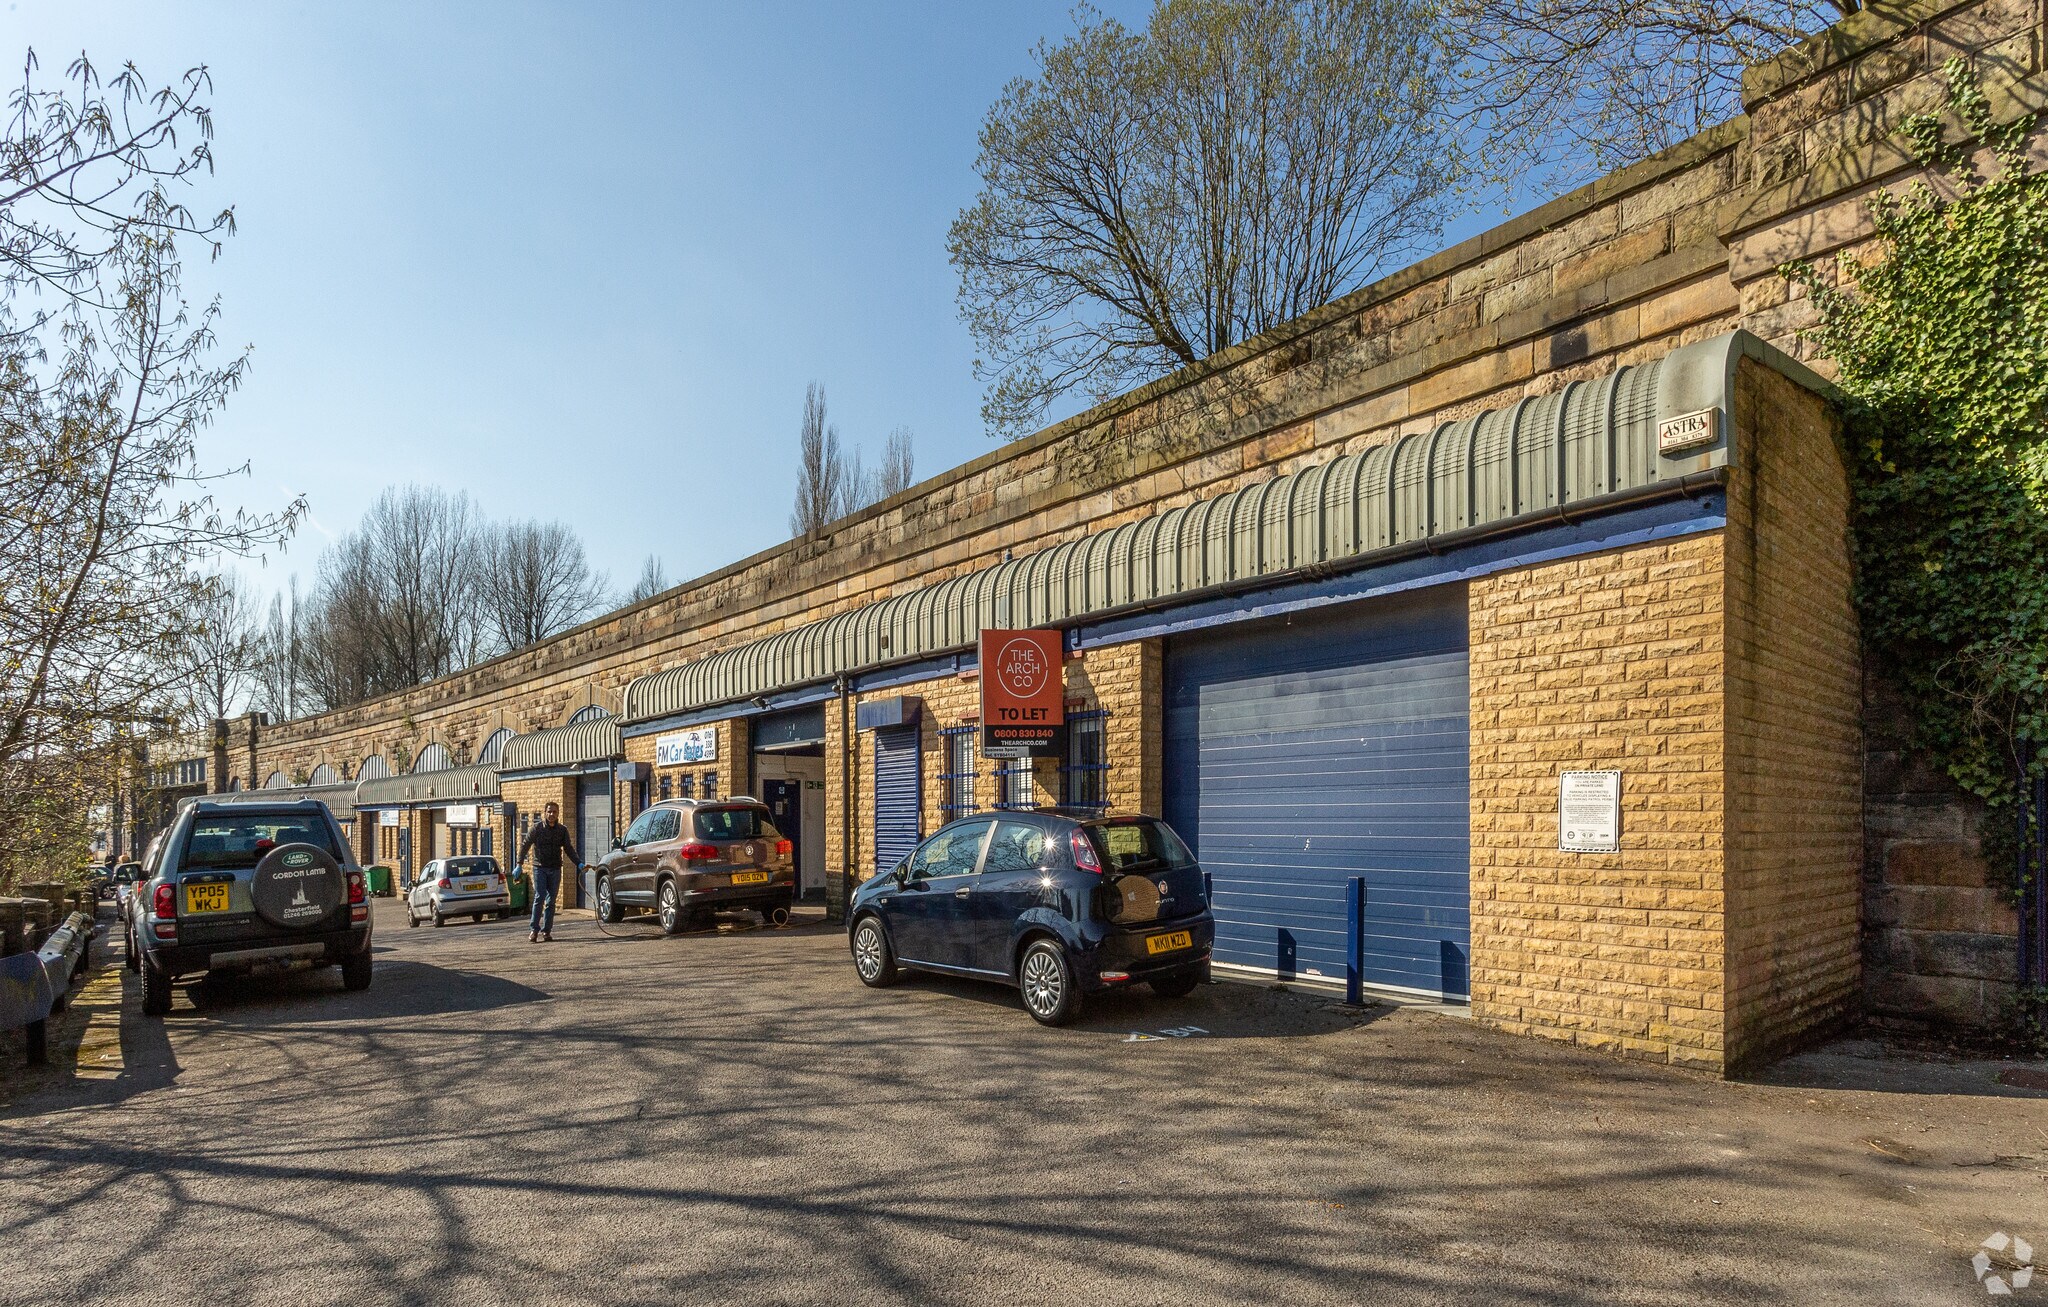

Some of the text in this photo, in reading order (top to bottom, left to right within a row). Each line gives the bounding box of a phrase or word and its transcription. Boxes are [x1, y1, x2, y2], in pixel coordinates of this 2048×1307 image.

[1666, 416, 1705, 437] ASTRA
[1010, 649, 1034, 661] THE
[1006, 662, 1040, 674] ARCH
[1013, 675, 1033, 687] CO
[998, 708, 1048, 721] TO LET
[994, 730, 1017, 738] 0800
[1019, 730, 1035, 738] 830
[657, 745, 669, 763] FM
[670, 744, 683, 762] Car
[272, 868, 326, 880] GORDON LAMB
[190, 885, 225, 898] YP05
[195, 899, 221, 910] WKJ
[284, 905, 320, 914] Chesterfield
[1153, 936, 1171, 951] MK11
